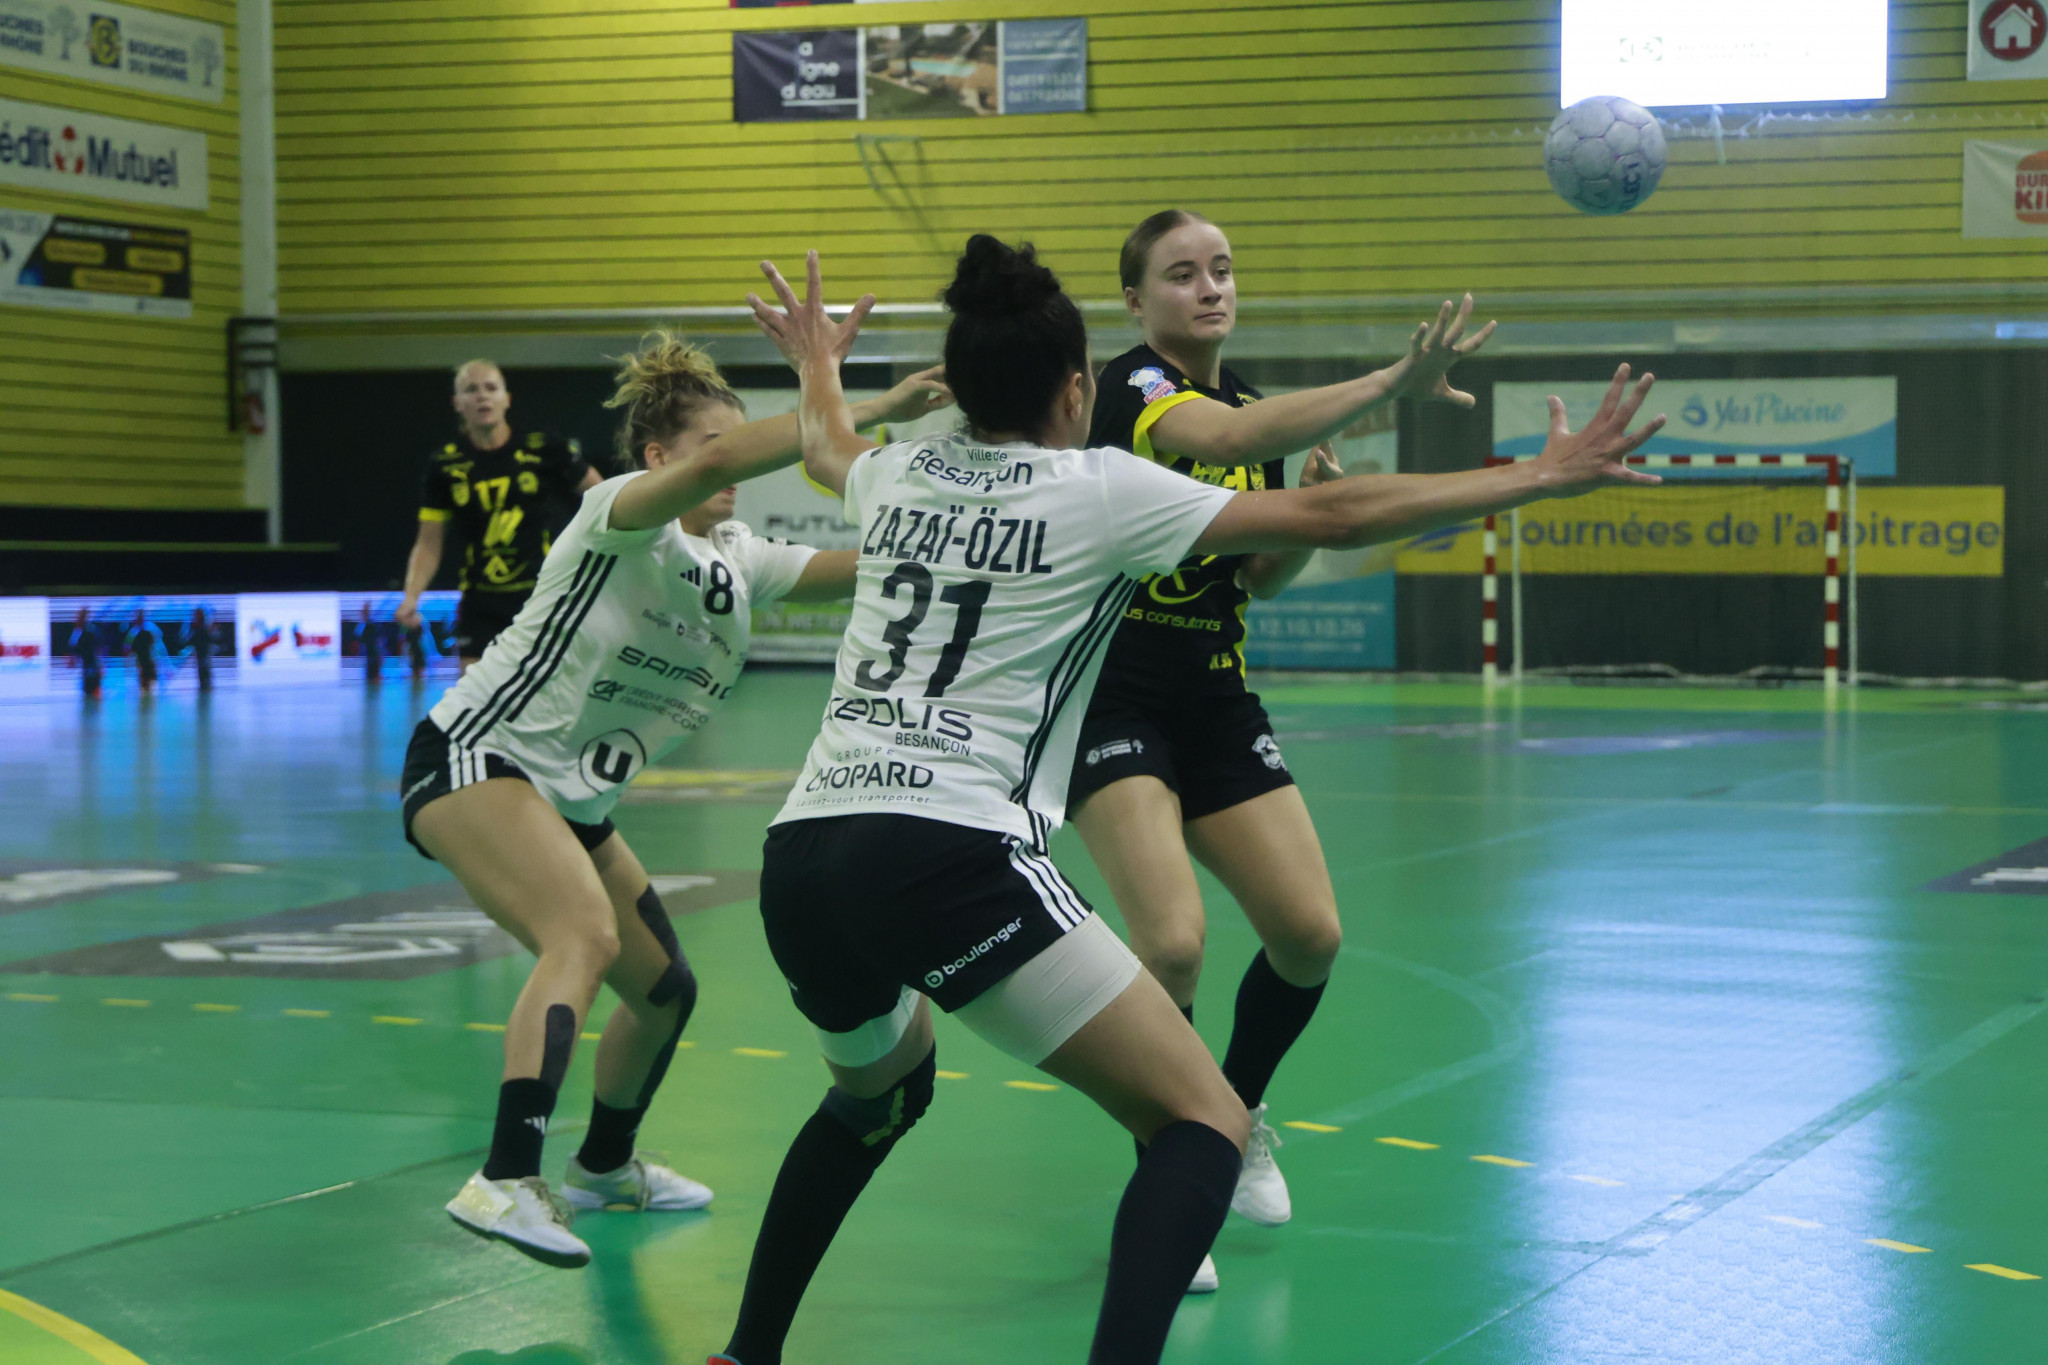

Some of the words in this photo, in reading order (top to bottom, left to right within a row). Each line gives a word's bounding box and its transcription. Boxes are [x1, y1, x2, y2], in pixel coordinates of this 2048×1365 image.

[0, 119, 50, 170] édit
[87, 135, 178, 187] Mutuel
[2016, 174, 2048, 188] BUR
[2016, 190, 2048, 210] KI
[1754, 392, 1847, 424] Piscine
[909, 449, 1034, 494] Besançon
[966, 448, 992, 461] Ville
[994, 448, 1008, 463] de
[766, 514, 860, 533] FUTU
[862, 504, 1052, 574] ZAZAÏ-ÖZIL
[1705, 512, 1759, 547] de
[1774, 511, 2001, 555] l'abitrage
[704, 560, 735, 615] 8
[854, 561, 993, 698] 31
[1146, 610, 1223, 633] consultants
[618, 695, 700, 732] FRANCHE-COM
[836, 747, 895, 762] GROUPE
[895, 731, 971, 757] BESANÇON
[591, 741, 633, 784] U
[805, 761, 934, 793] CHOPARD
[858, 794, 931, 805] transporter
[942, 917, 1022, 976] boulanger
